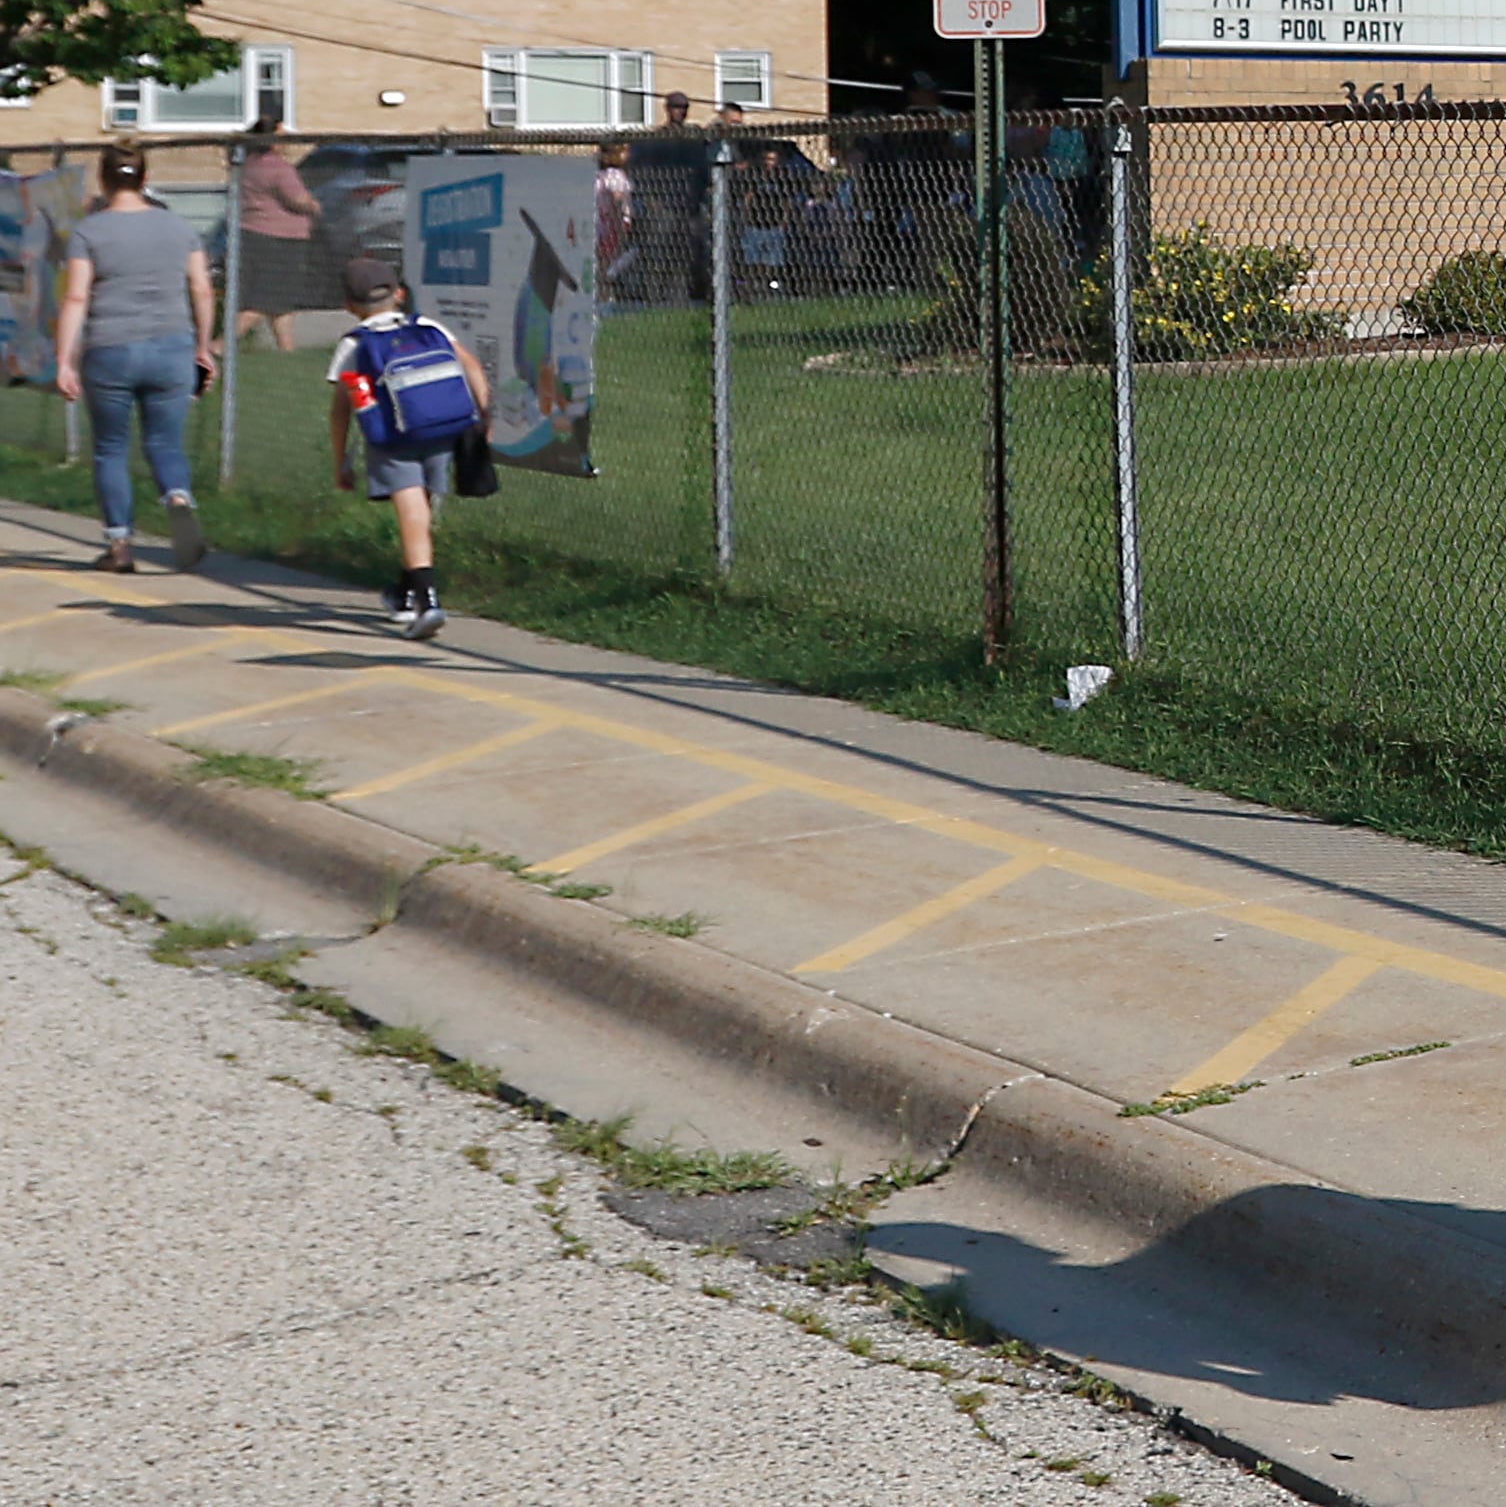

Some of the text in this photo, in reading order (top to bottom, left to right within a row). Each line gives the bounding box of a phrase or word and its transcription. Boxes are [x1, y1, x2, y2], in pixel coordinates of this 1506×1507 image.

[969, 0, 1012, 19] STOP
[1213, 17, 1404, 43] 8-3 POOL PARTY
